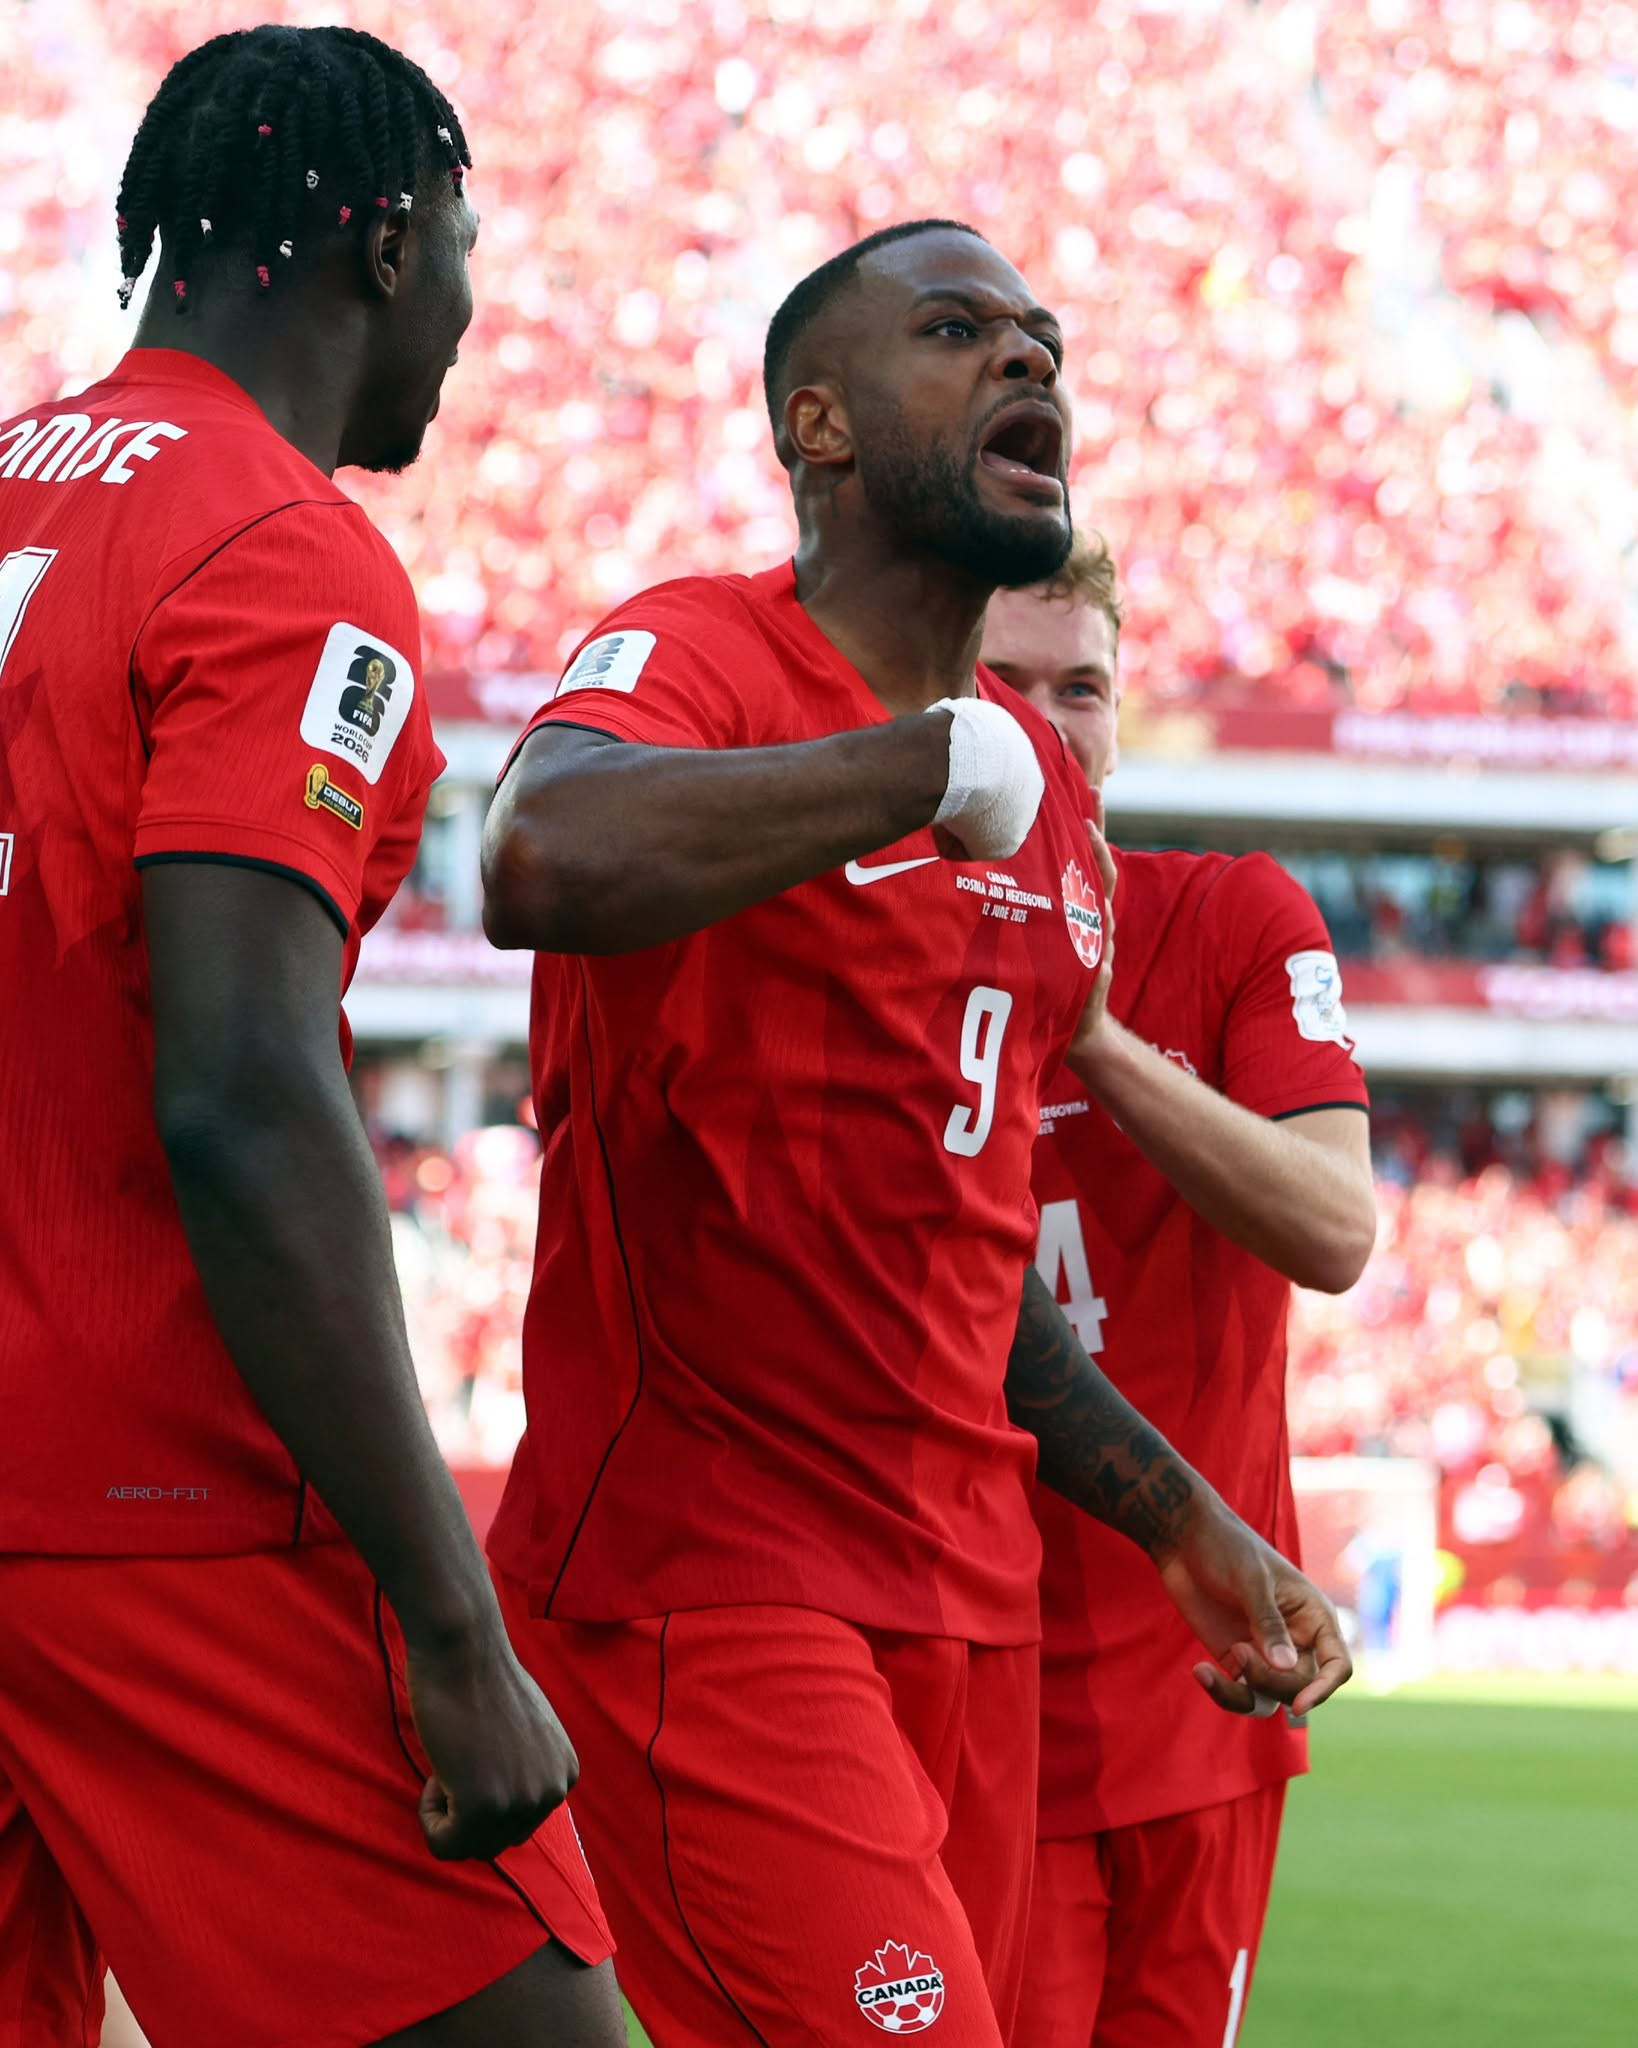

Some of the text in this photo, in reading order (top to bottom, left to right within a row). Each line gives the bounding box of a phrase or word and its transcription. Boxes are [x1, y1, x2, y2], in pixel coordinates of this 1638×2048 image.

[352, 709, 373, 729] FIFA
[330, 732, 369, 764] 2026
[334, 723, 373, 751] WORLD CUP
[323, 786, 360, 816] DEBUT
[956, 875, 1053, 911] BOSNIA AND HERZEGOVINA
[982, 902, 991, 916] 12
[990, 904, 1010, 920] JUNE
[1065, 903, 1101, 931] CANADA
[943, 986, 1013, 1157] 9
[1034, 1199, 1109, 1355] 4
[106, 1486, 213, 1500] AERO-FIT
[858, 1976, 942, 2005] CANADA
